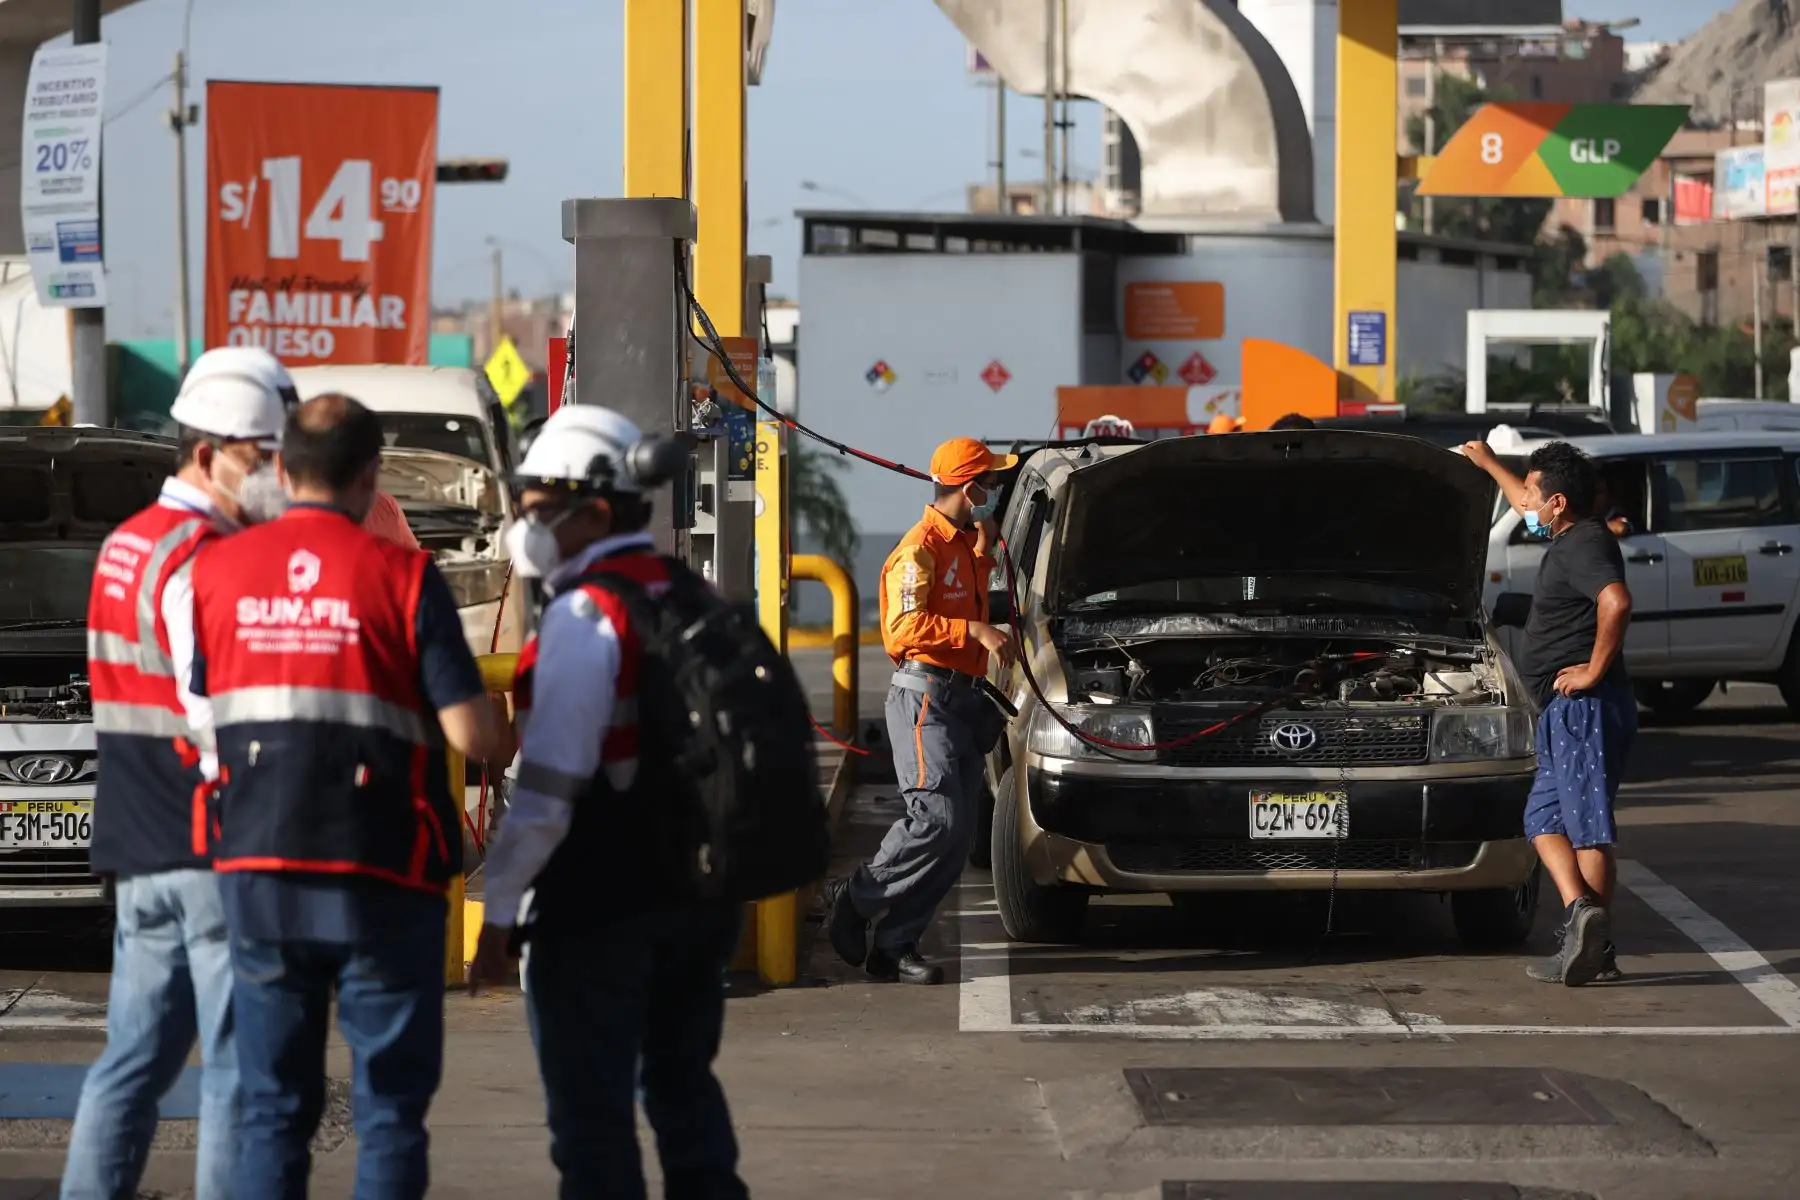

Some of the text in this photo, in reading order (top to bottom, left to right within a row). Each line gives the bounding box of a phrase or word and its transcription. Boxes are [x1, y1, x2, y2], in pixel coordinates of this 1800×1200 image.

[36, 77, 96, 93] INCENTIVO
[32, 92, 97, 106] TRIBUTARIO
[36, 139, 92, 173] 20%
[1481, 132, 1503, 164] 8
[1569, 138, 1621, 164] GLP
[262, 155, 384, 262] 14
[228, 289, 407, 330] FAMILIAR
[227, 326, 335, 358] QUESO
[1092, 425, 1131, 438] TAXI
[27, 802, 63, 812] PERU
[1283, 793, 1317, 802] PERU
[0, 812, 91, 841] F3M-506
